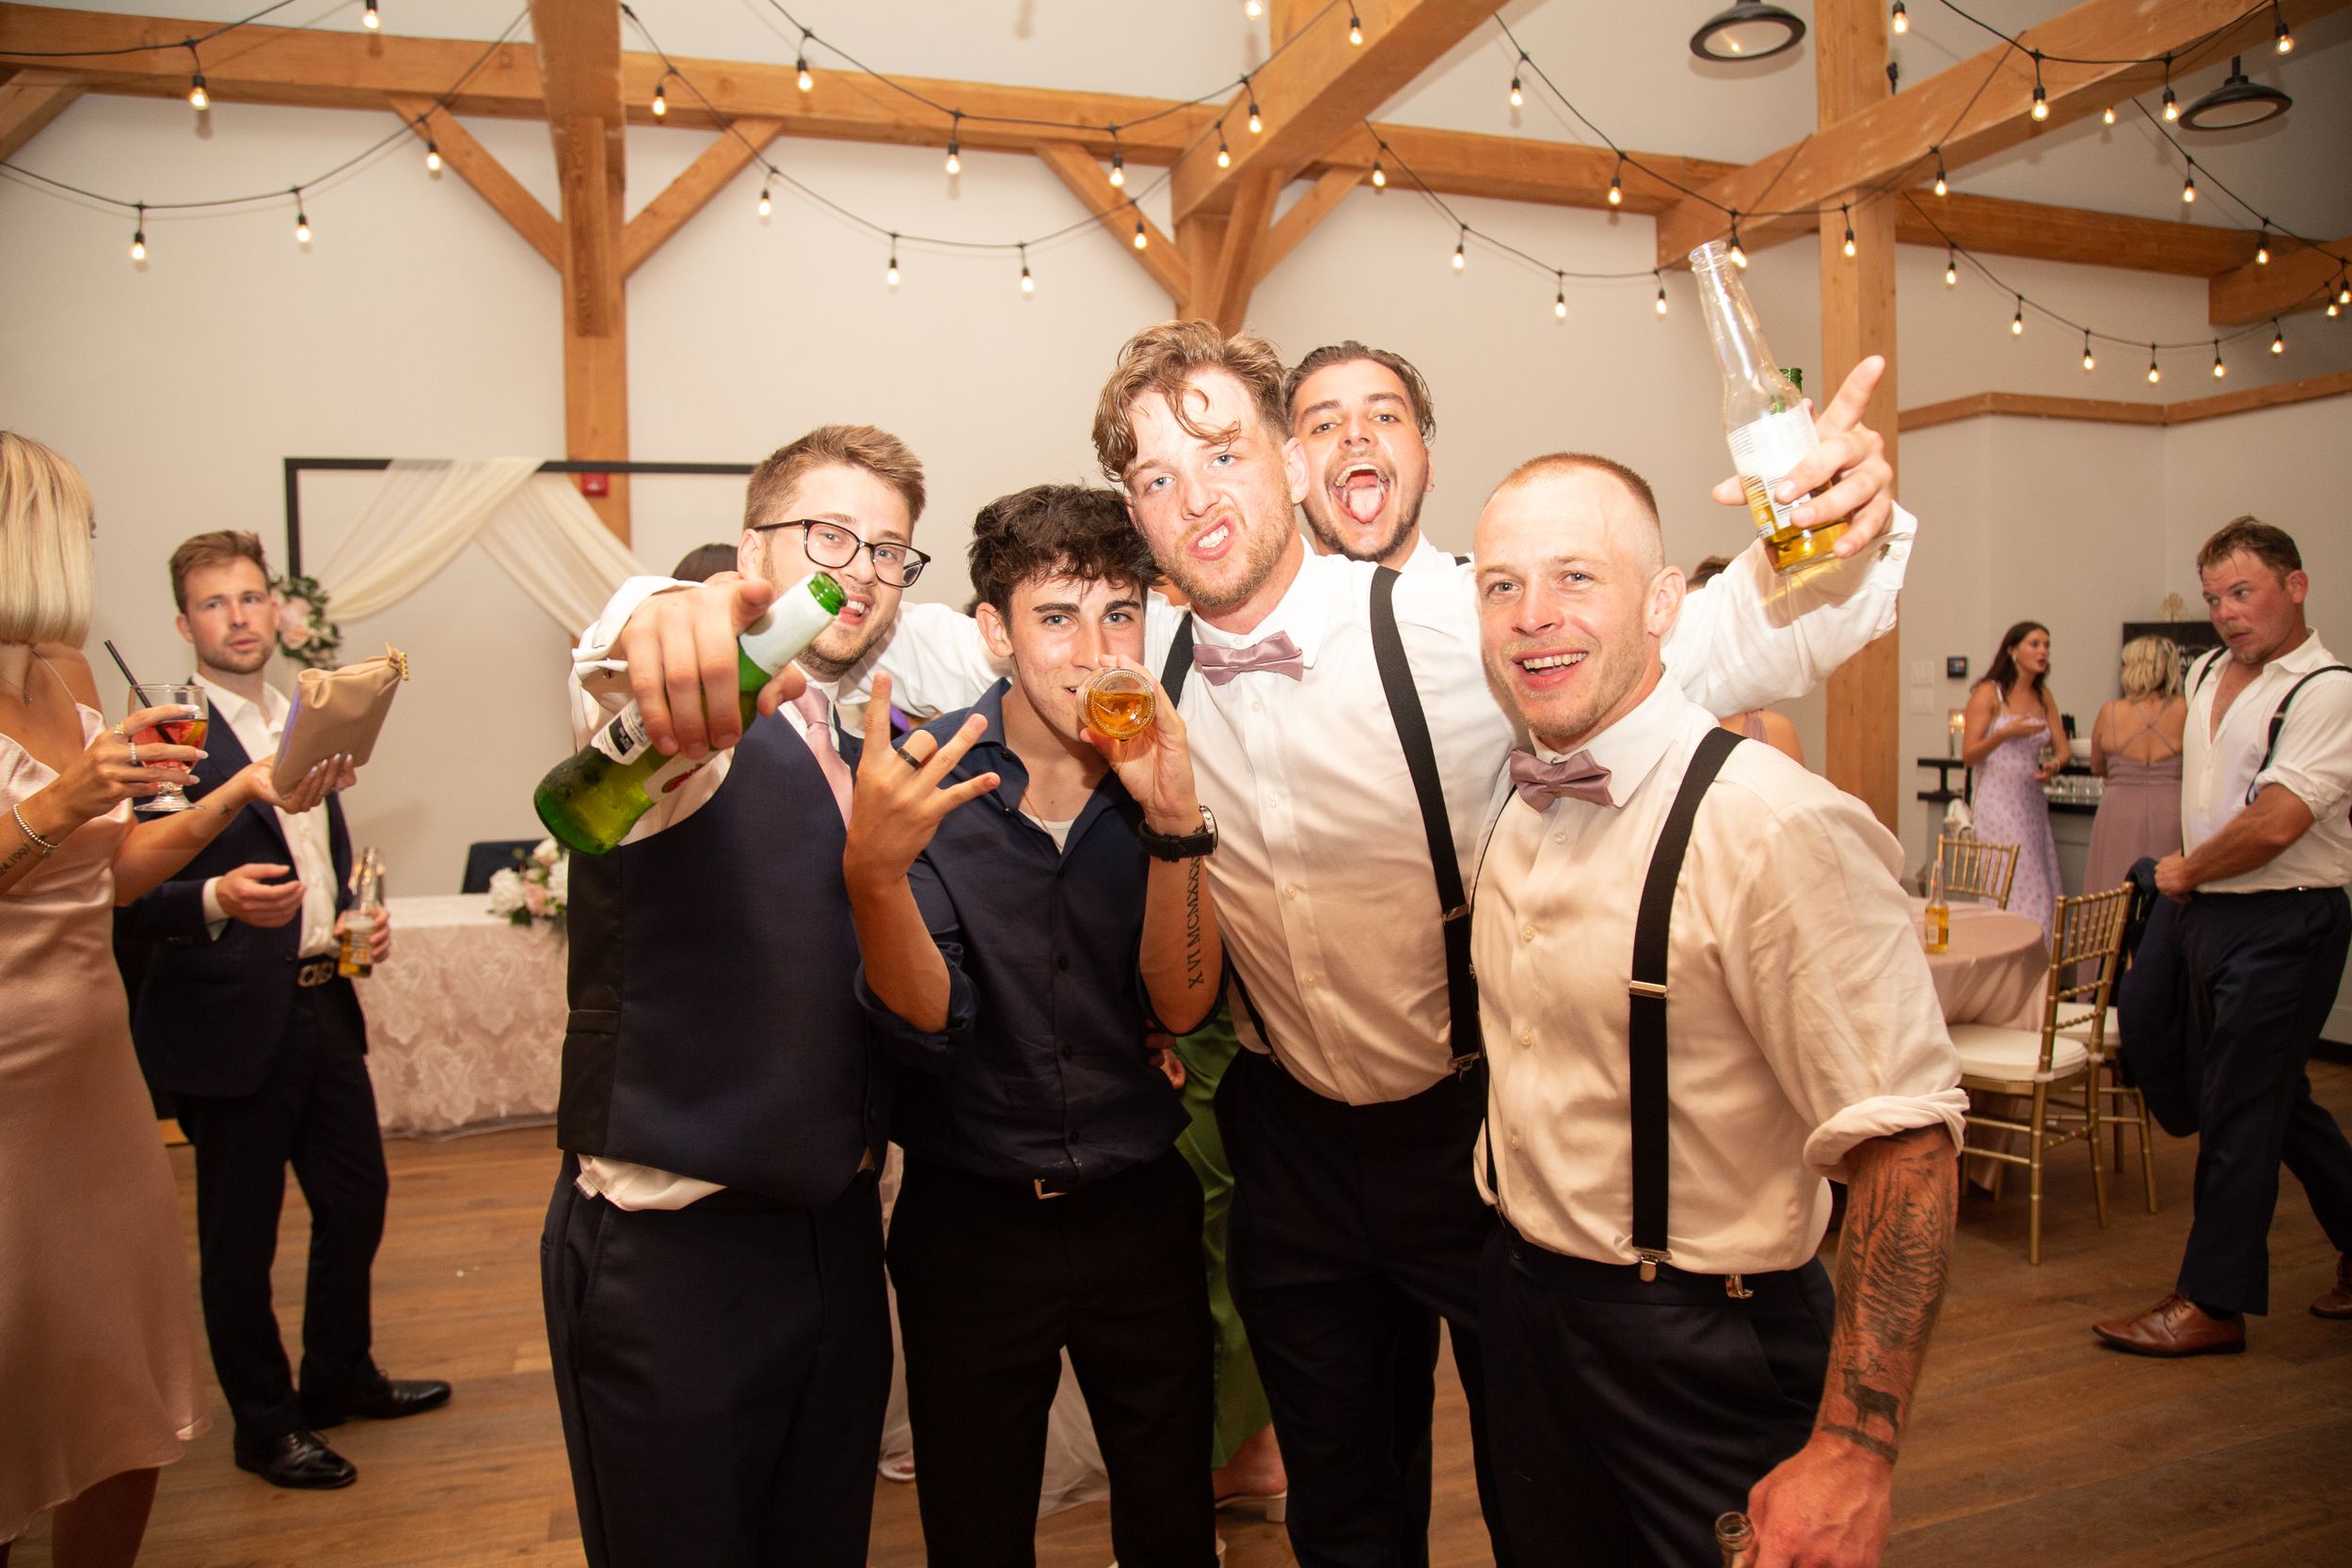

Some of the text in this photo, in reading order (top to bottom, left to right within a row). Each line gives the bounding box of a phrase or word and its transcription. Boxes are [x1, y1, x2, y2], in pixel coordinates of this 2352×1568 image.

[1187, 856, 1204, 990] X VI MCMXXX
